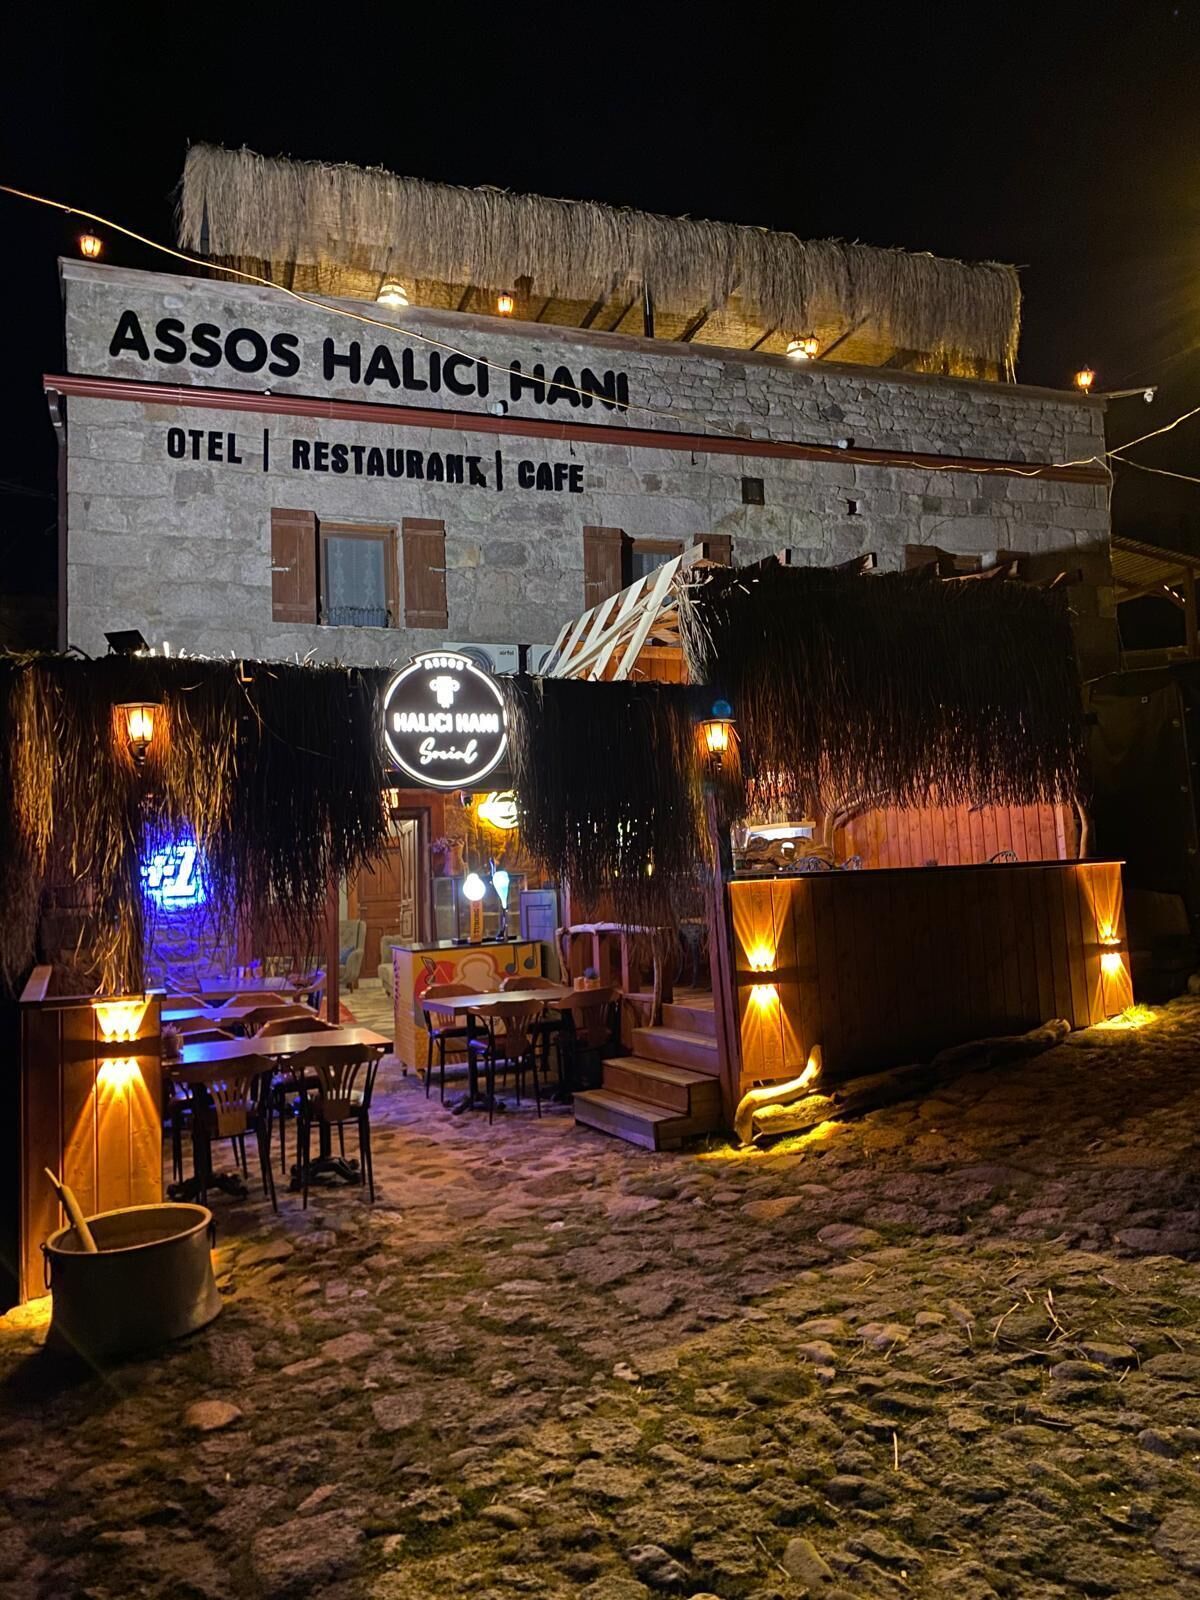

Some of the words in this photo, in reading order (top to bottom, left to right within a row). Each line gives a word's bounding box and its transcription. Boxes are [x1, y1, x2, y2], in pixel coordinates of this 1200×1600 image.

[109, 310, 300, 377] ASSOS
[322, 338, 489, 398] HALICI
[509, 359, 629, 411] HANI
[167, 427, 243, 465] OTEL
[292, 439, 482, 485] RESTAURANT
[517, 461, 585, 494] CAFE
[424, 657, 464, 671] ASSOS
[393, 712, 453, 732] HALICI
[455, 713, 499, 733] HANI
